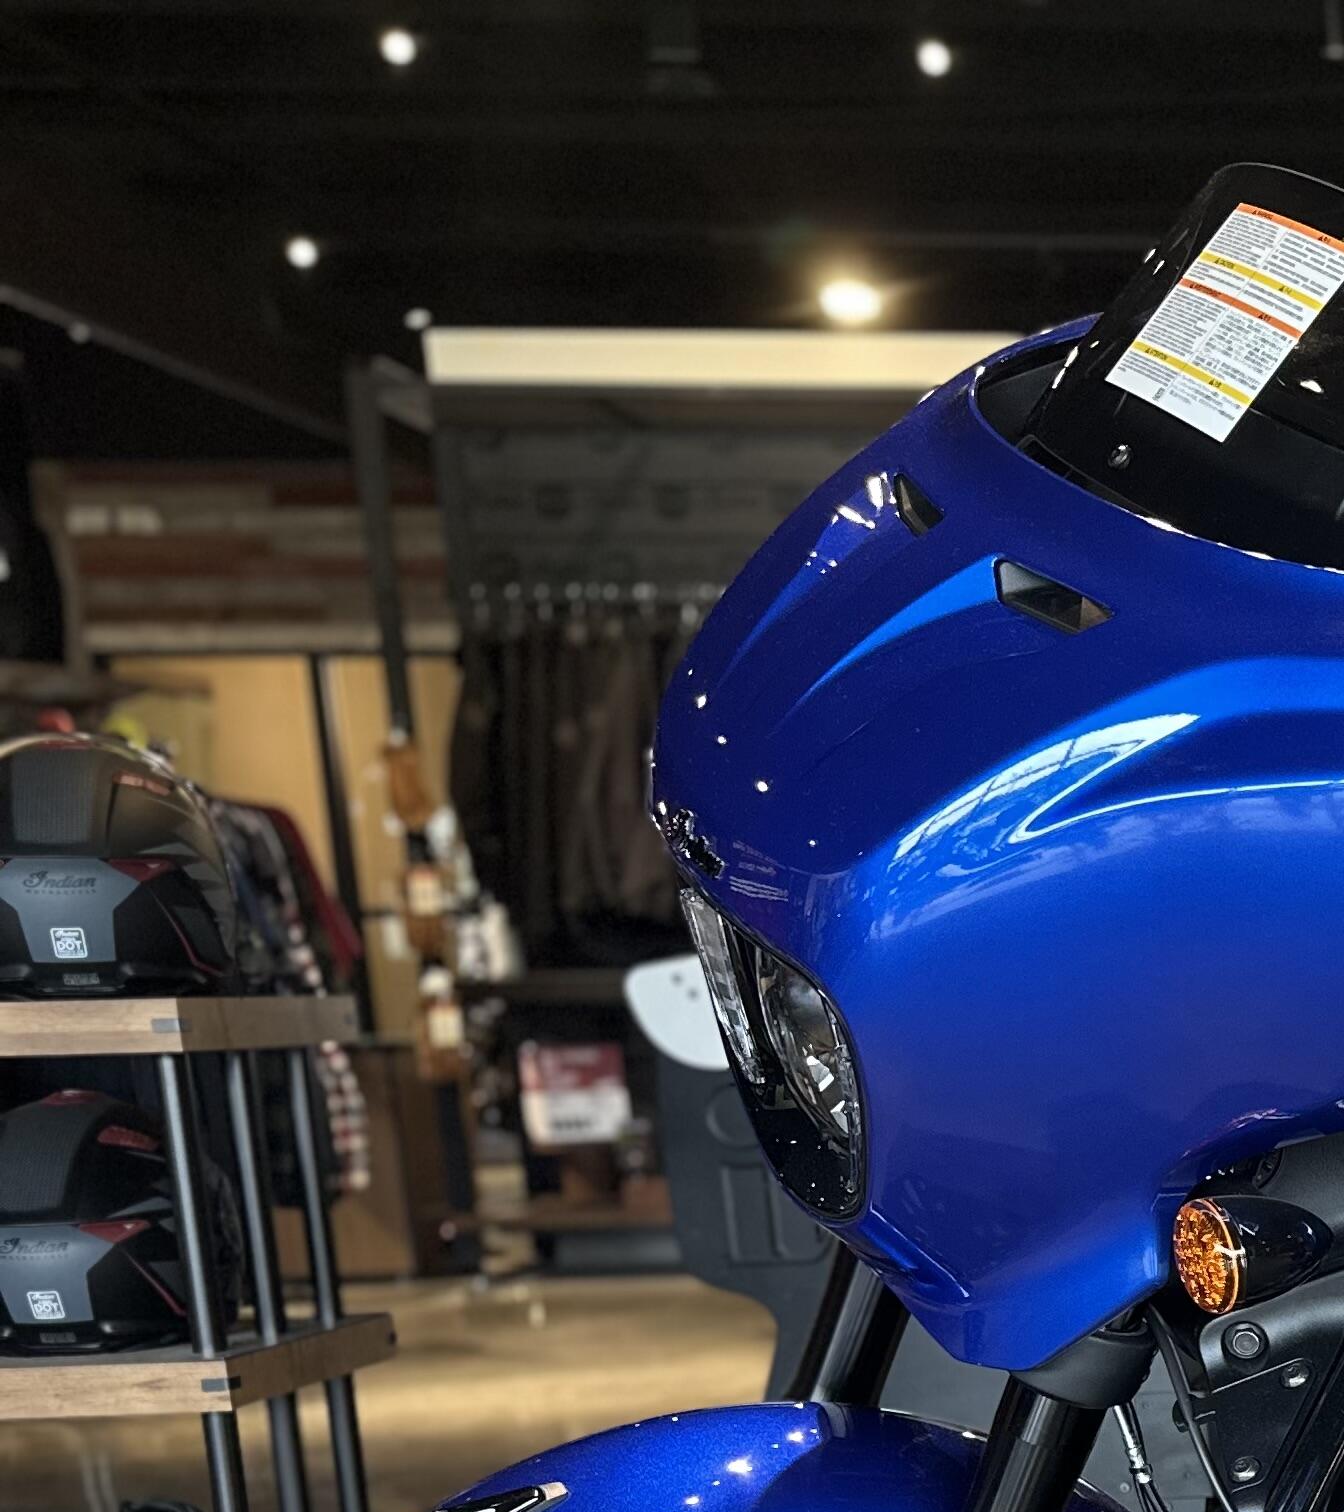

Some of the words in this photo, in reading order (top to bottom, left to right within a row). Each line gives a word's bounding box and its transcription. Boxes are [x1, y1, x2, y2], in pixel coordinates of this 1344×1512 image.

[23, 871, 97, 889] Indian
[56, 941, 82, 951] DOT
[33, 1303, 59, 1313] DOT
